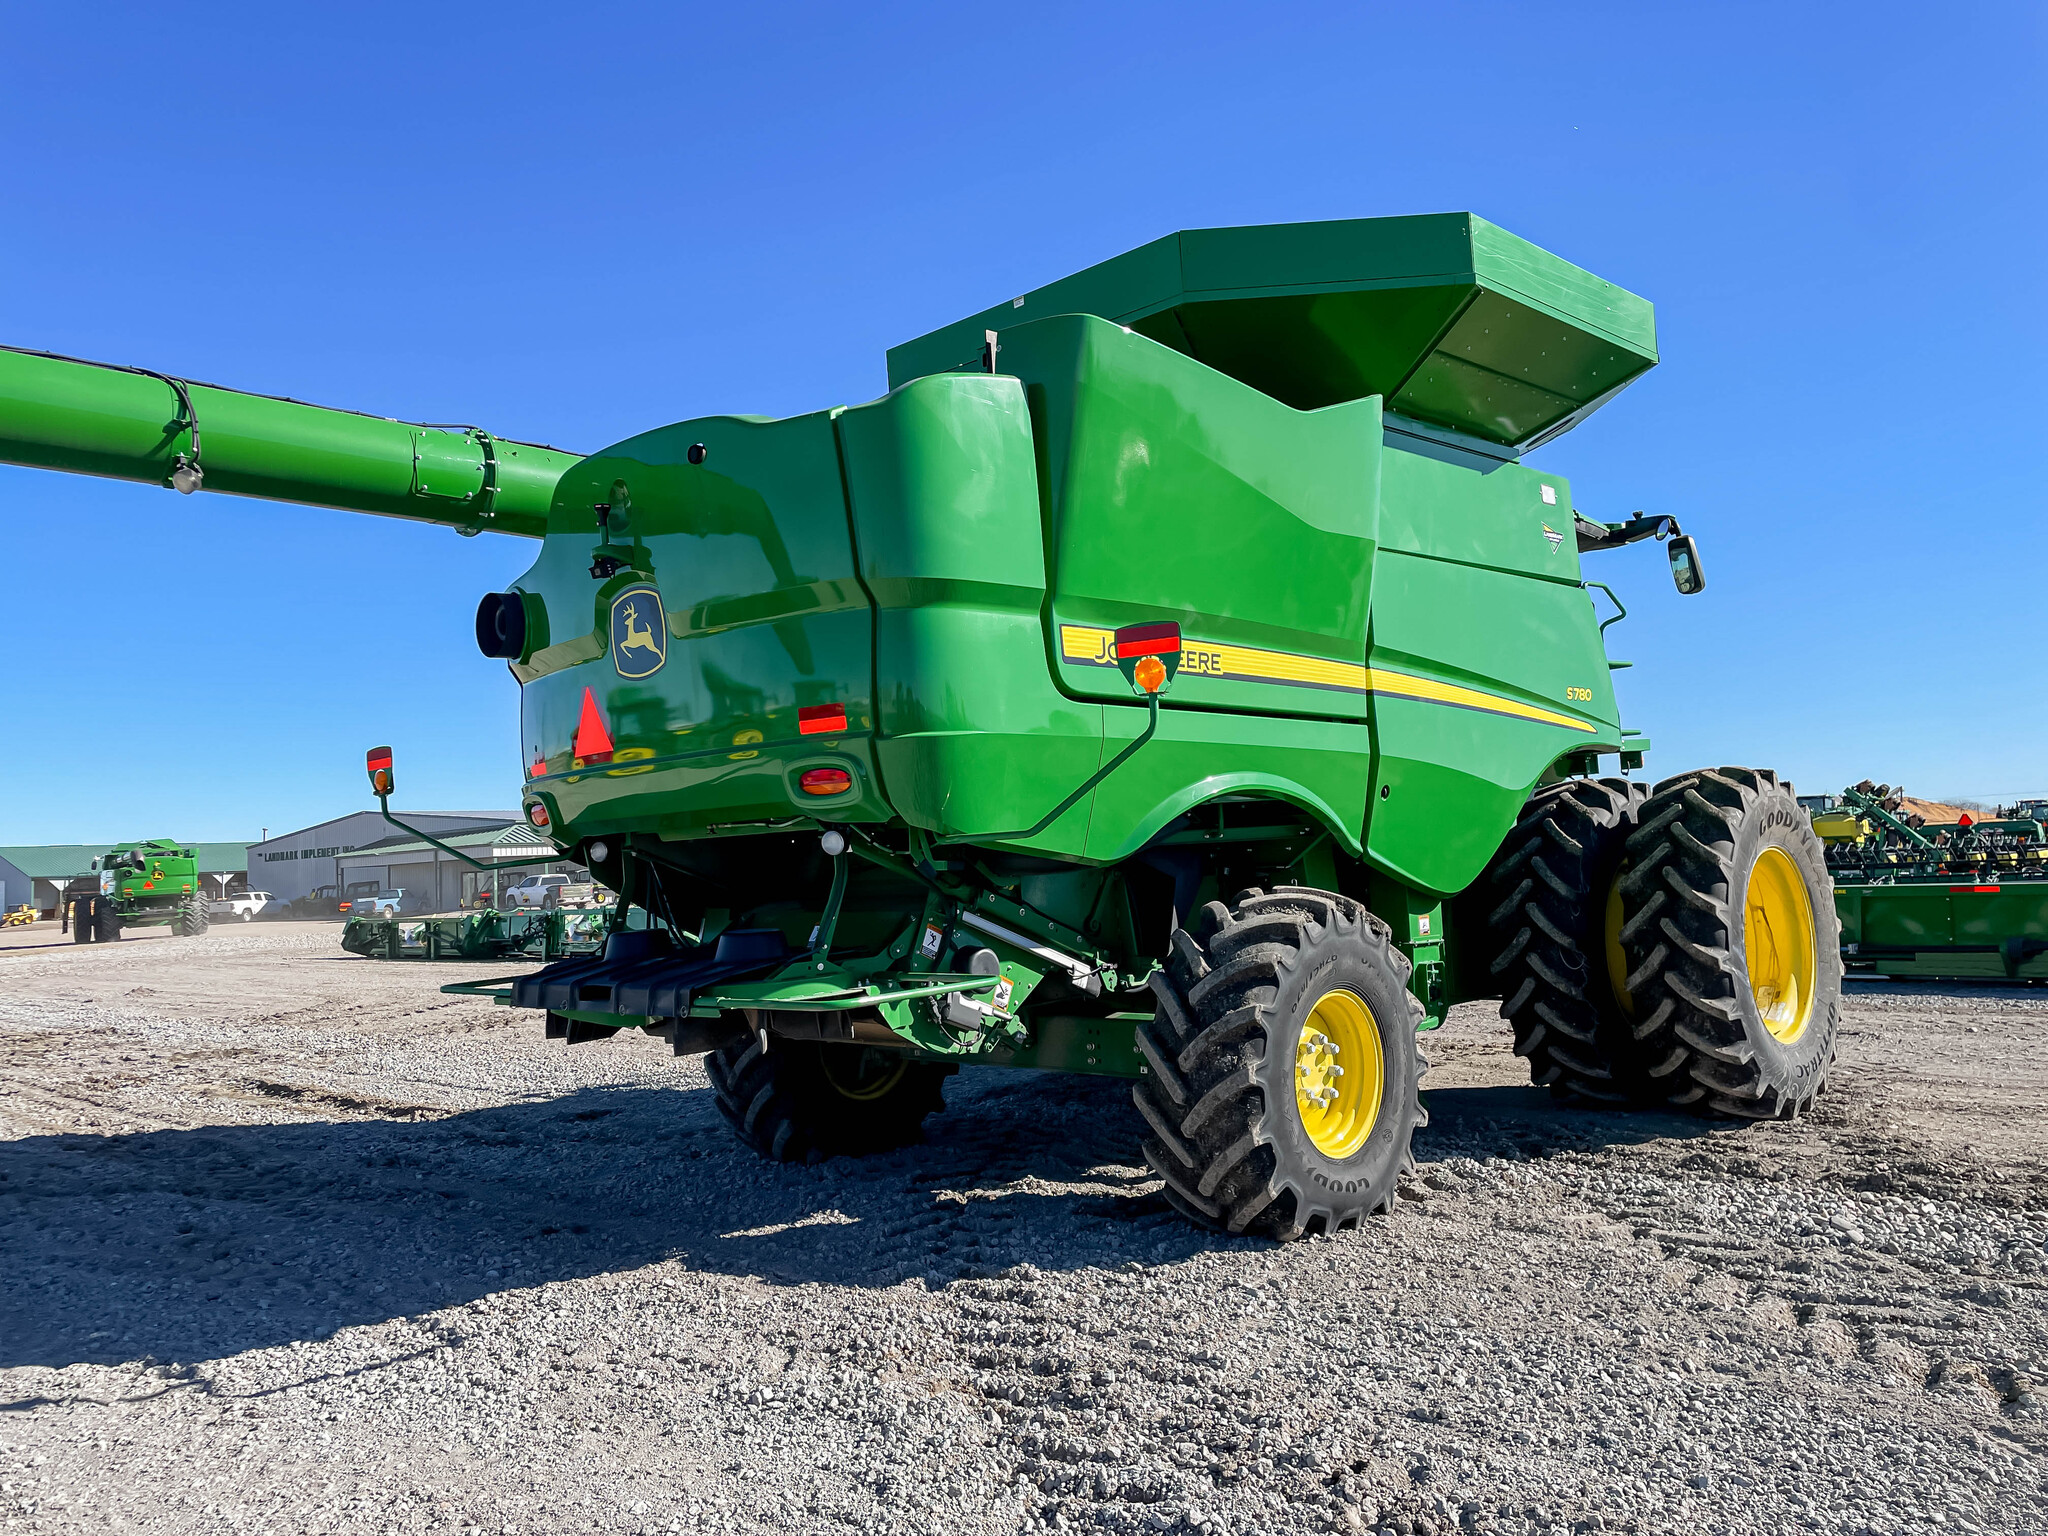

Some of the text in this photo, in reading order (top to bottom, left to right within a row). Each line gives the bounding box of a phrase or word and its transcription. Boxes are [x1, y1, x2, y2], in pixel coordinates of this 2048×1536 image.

[1566, 687, 1593, 703] S780
[264, 850, 298, 862] LANDMARK
[301, 846, 340, 859] IMPLEMENT
[1795, 1001, 1836, 1078] OPTITRAC
